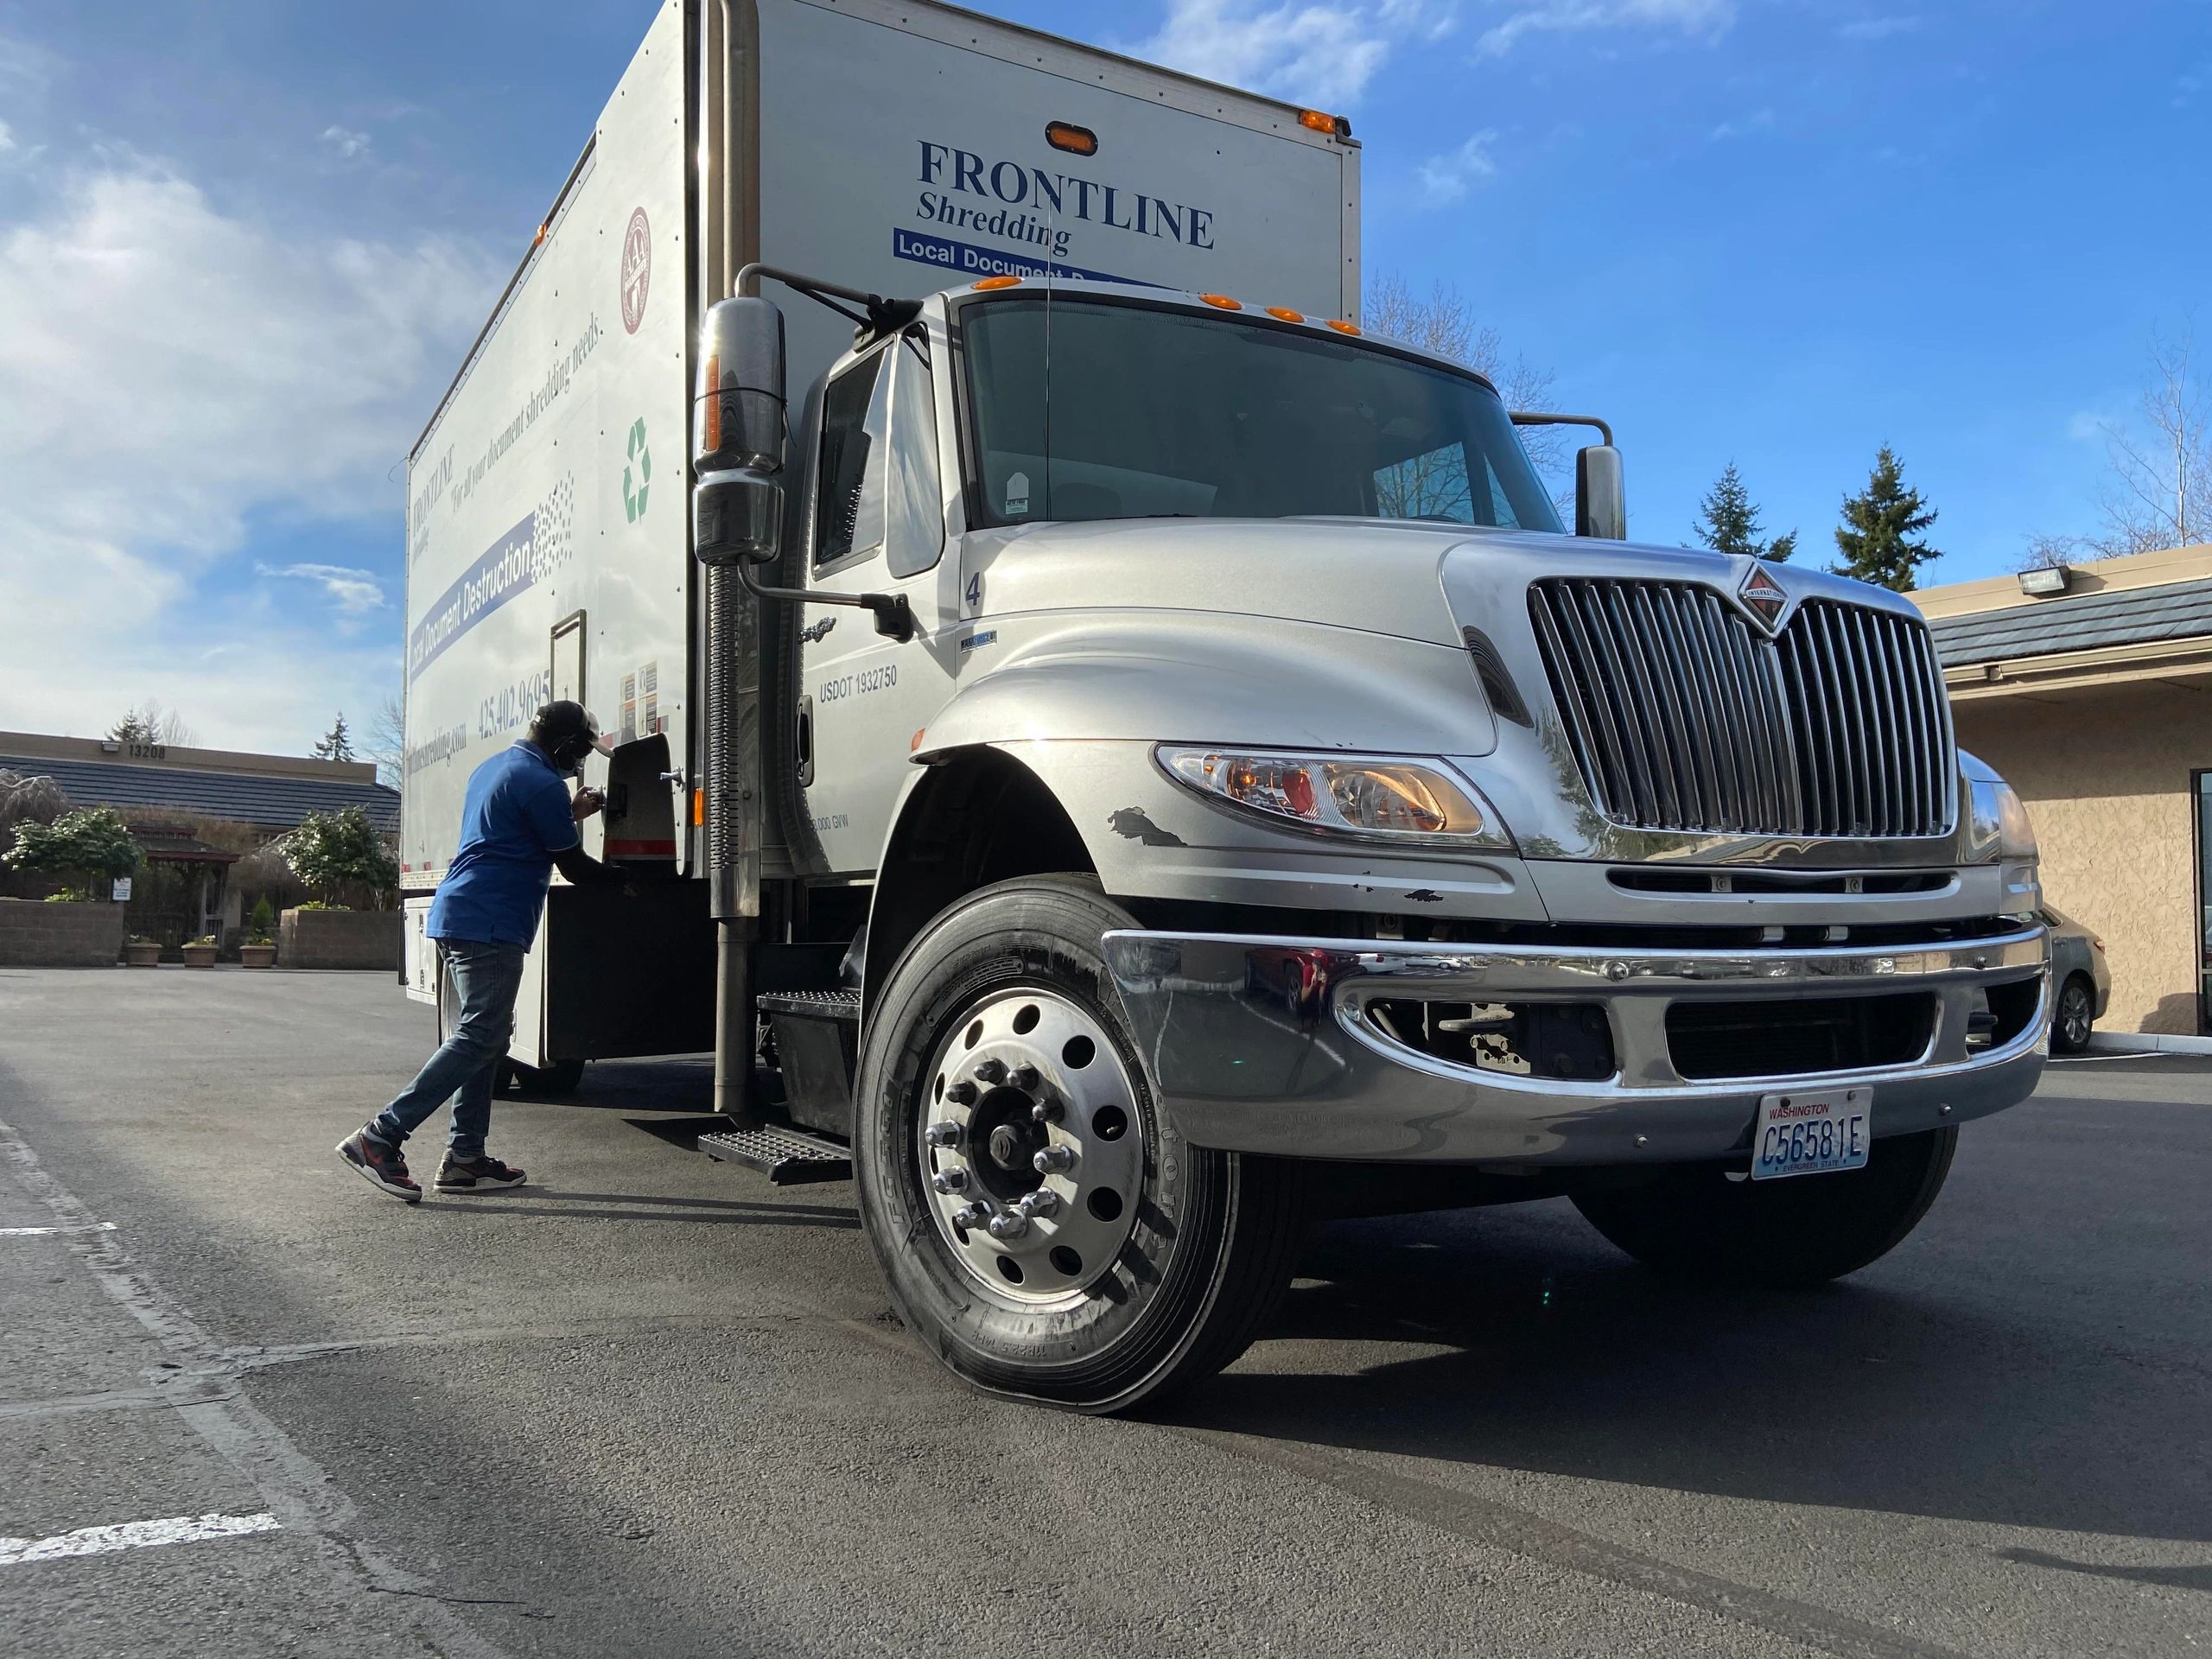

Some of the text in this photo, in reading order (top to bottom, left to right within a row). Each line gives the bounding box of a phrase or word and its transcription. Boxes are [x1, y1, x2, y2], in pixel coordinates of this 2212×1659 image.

[917, 140, 1215, 250] FRONTLINE
[899, 234, 955, 264] Local
[916, 191, 1072, 257] Shredding
[487, 405, 524, 469] document
[526, 359, 570, 429] shredding
[425, 591, 461, 657] Document
[463, 541, 530, 620] Destruction
[966, 571, 981, 606] 4
[479, 669, 550, 741] 425.402.9695
[820, 664, 897, 703] USDOT 1932750
[1770, 1103, 1829, 1120] WASHINGTON
[1762, 1116, 1863, 1166] C56581E
[1783, 1161, 1818, 1173] EVERGREEN
